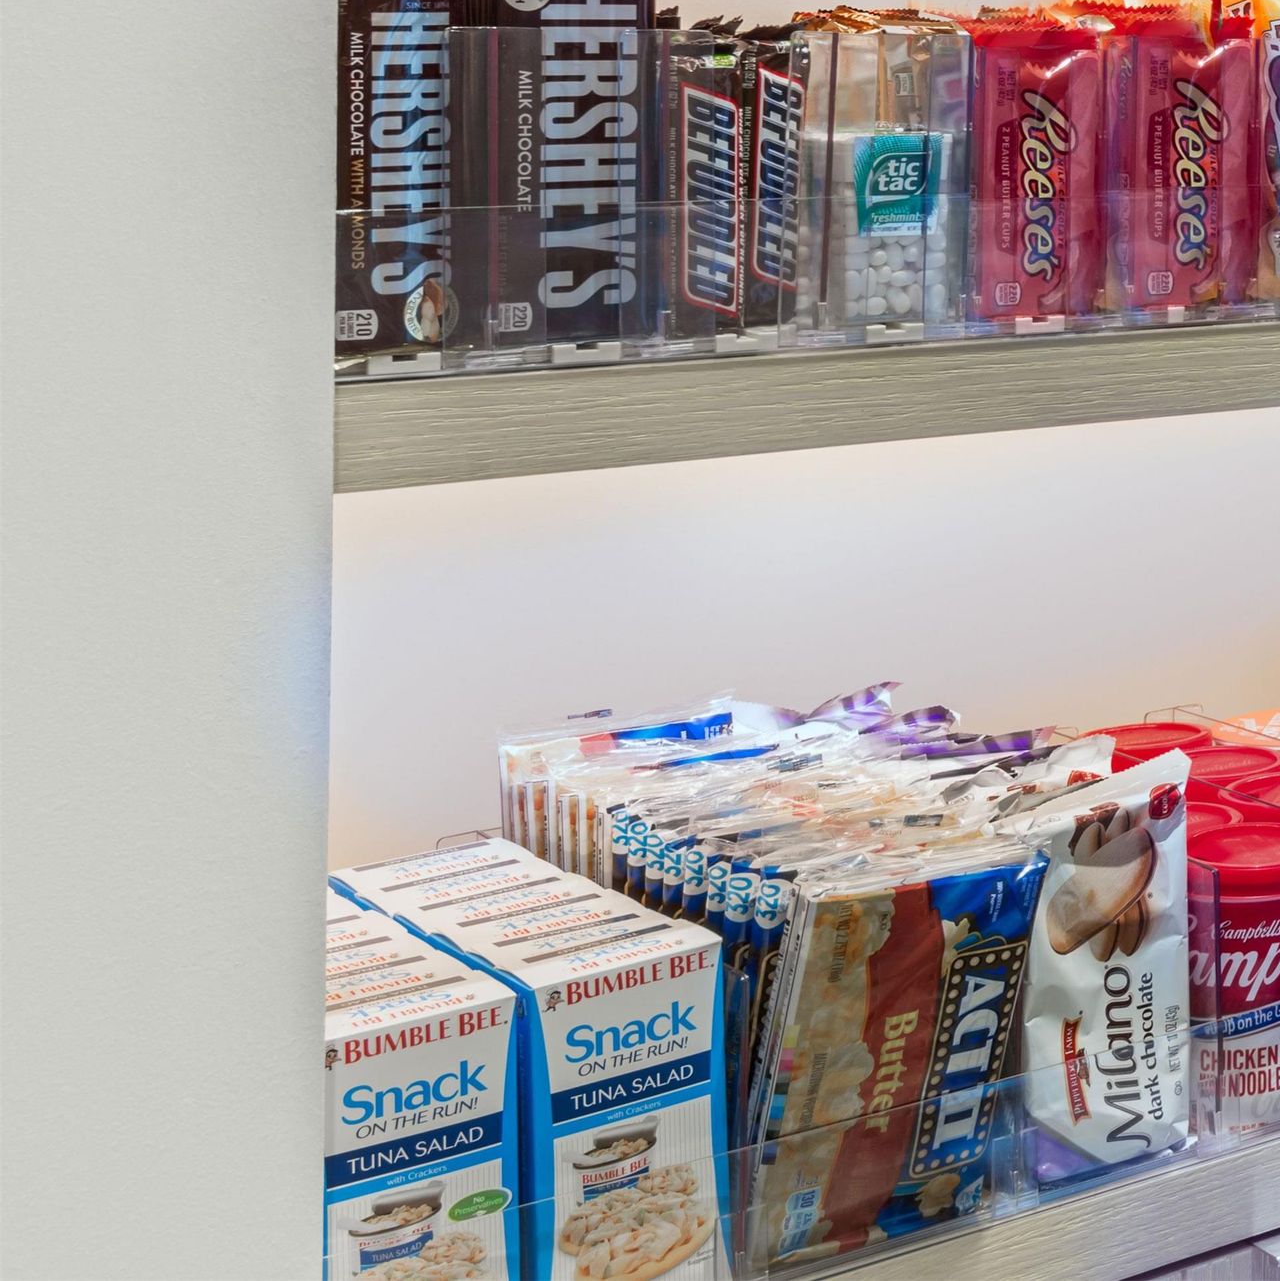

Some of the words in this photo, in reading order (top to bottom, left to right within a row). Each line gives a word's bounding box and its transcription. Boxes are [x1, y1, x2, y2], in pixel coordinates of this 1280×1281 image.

[517, 70, 533, 109] MILK
[1001, 126, 1010, 134] 2
[1155, 116, 1163, 124] 2
[370, 11, 453, 297] HERSHEY'S
[517, 112, 533, 213] CHOCOLATE
[887, 158, 921, 177] tic
[1001, 135, 1011, 177] PEANUT
[1154, 125, 1163, 168] PEANUT
[877, 175, 919, 191] tac
[1022, 92, 1077, 280] Reese's
[1154, 169, 1163, 206] BUTTER
[1174, 80, 1230, 270] Reese's
[1001, 179, 1011, 218] BUTTER
[1001, 221, 1011, 249] CUPS
[1154, 212, 1163, 238] CUPS
[726, 876, 753, 915] 320
[755, 884, 781, 921] 320
[565, 961, 663, 1006] BUMBLE
[344, 1019, 452, 1065] BUMBLE
[565, 1001, 697, 1064] Snack
[949, 974, 1005, 1075] ACT
[1063, 1026, 1076, 1055] FARM
[1136, 971, 1158, 1071] chocolate
[578, 1059, 606, 1078] ON
[610, 1048, 645, 1069] THE
[647, 1036, 689, 1059] RUN!
[864, 1009, 919, 1134] Butter
[1096, 965, 1152, 1149] Milano
[1200, 1046, 1280, 1072] CHICKEN
[342, 1060, 488, 1126] Snack
[570, 1084, 627, 1111] TUNA
[632, 1064, 694, 1094] SALAD
[1147, 1076, 1163, 1120] dark
[355, 1116, 388, 1139] ON
[391, 1109, 434, 1131] THE
[434, 1097, 479, 1119] RUN!
[931, 1082, 986, 1150] II
[346, 1147, 409, 1175] TUNA
[414, 1126, 485, 1158] SALAD
[582, 1167, 626, 1185] BUMBLE
[629, 1157, 649, 1174] BEE
